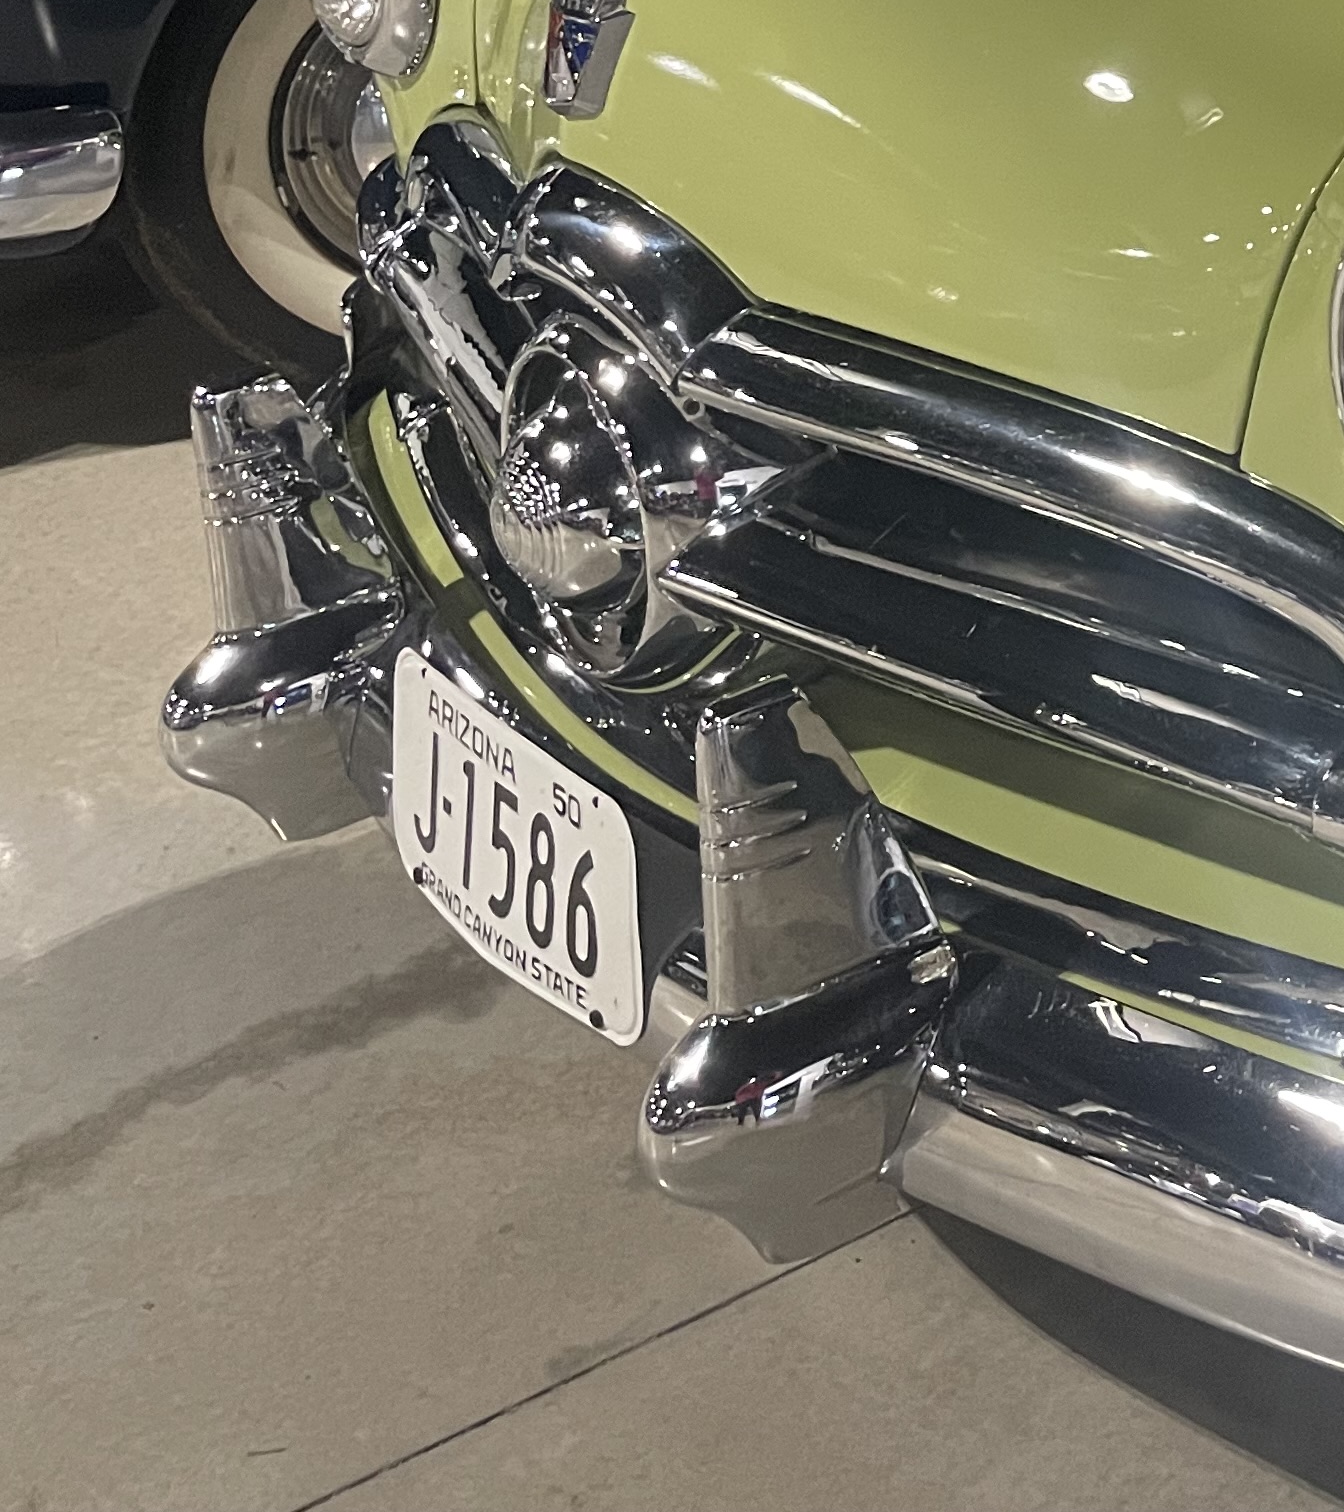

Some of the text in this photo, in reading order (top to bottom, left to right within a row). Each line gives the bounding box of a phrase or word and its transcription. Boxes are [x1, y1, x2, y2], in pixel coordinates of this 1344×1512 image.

[428, 689, 516, 784] ARIZONA
[413, 731, 598, 978] J-1586
[553, 782, 582, 829] 50
[420, 861, 588, 1009] GRAND CANYON STATE
